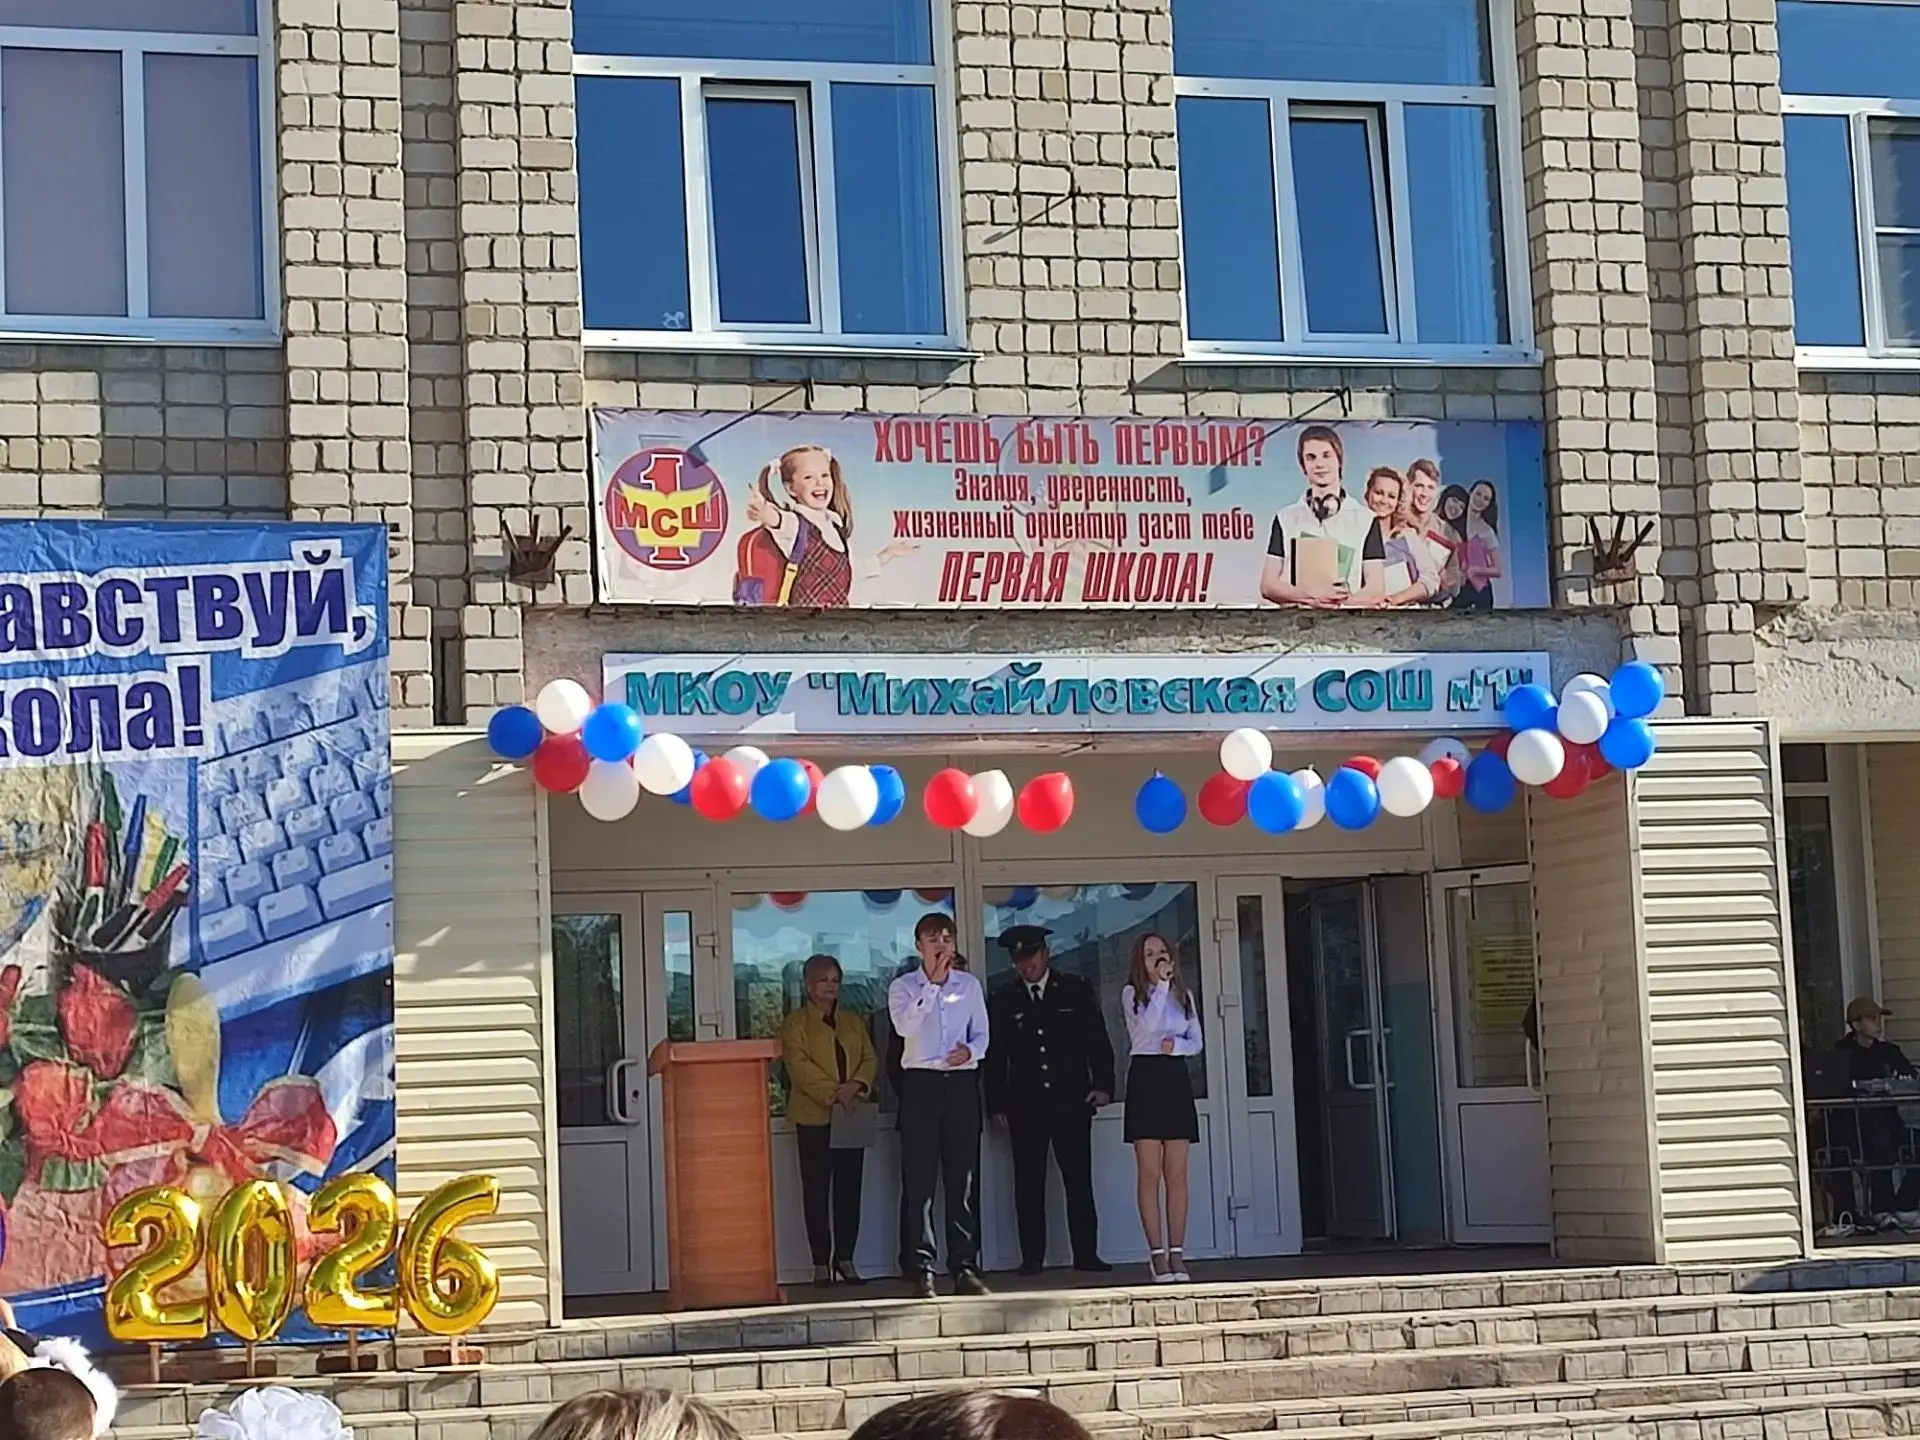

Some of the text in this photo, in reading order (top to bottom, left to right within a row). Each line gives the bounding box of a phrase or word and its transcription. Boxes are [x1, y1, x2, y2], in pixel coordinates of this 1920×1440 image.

[873, 420, 1265, 466] ХОЧЕШЬ БЫТЬ ПЕРВЫМ?
[611, 487, 722, 538] МСШ
[954, 468, 1191, 510] Знания, уверенность,
[893, 503, 1254, 547] жизненный ориентир даст тебе
[938, 551, 1213, 602] ПЕРВАЯ ШКОЛА!
[0, 665, 204, 757] ола!
[625, 671, 792, 715] МКОУ
[808, 662, 1297, 715] "Михайловская
[1312, 669, 1432, 713] СОШ
[105, 1172, 500, 1342] 2026
